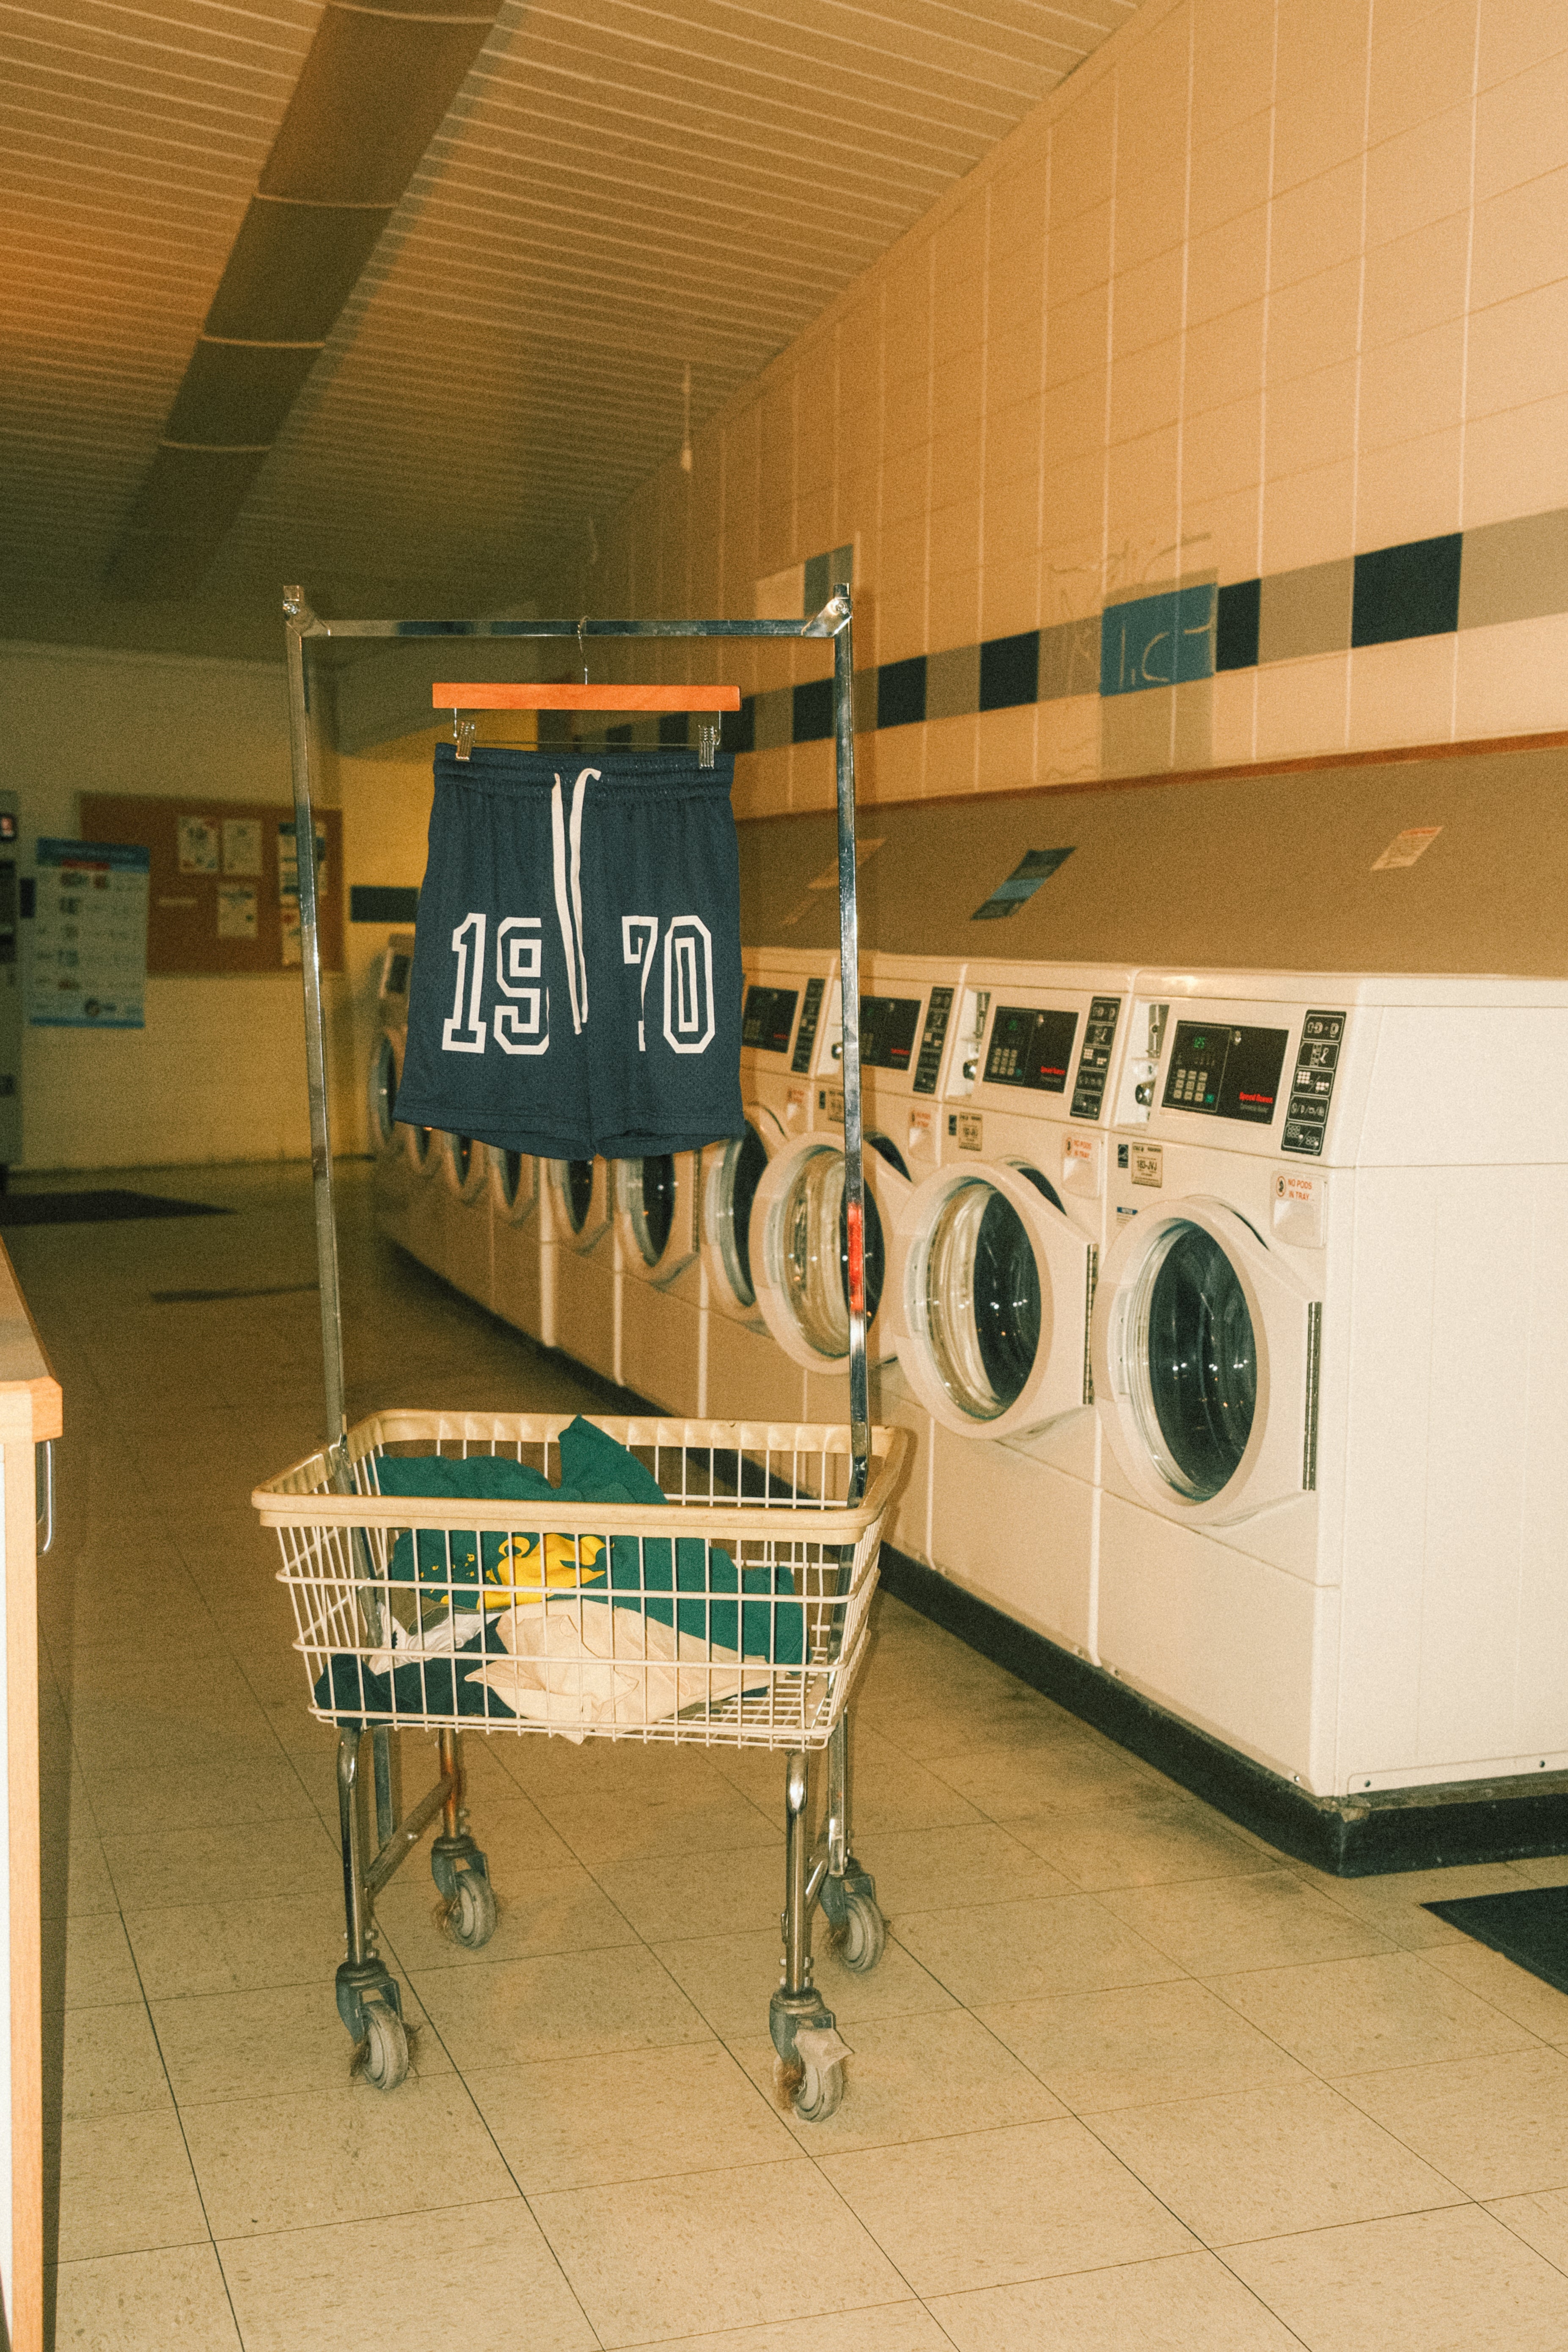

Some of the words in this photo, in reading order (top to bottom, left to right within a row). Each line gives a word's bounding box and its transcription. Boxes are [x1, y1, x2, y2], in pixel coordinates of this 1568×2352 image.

[442, 912, 550, 1055] 19
[622, 915, 715, 1054] 70
[1288, 1178, 1296, 1187] NO
[1297, 1180, 1312, 1190] PODS
[1296, 1191, 1310, 1200] TRAY
